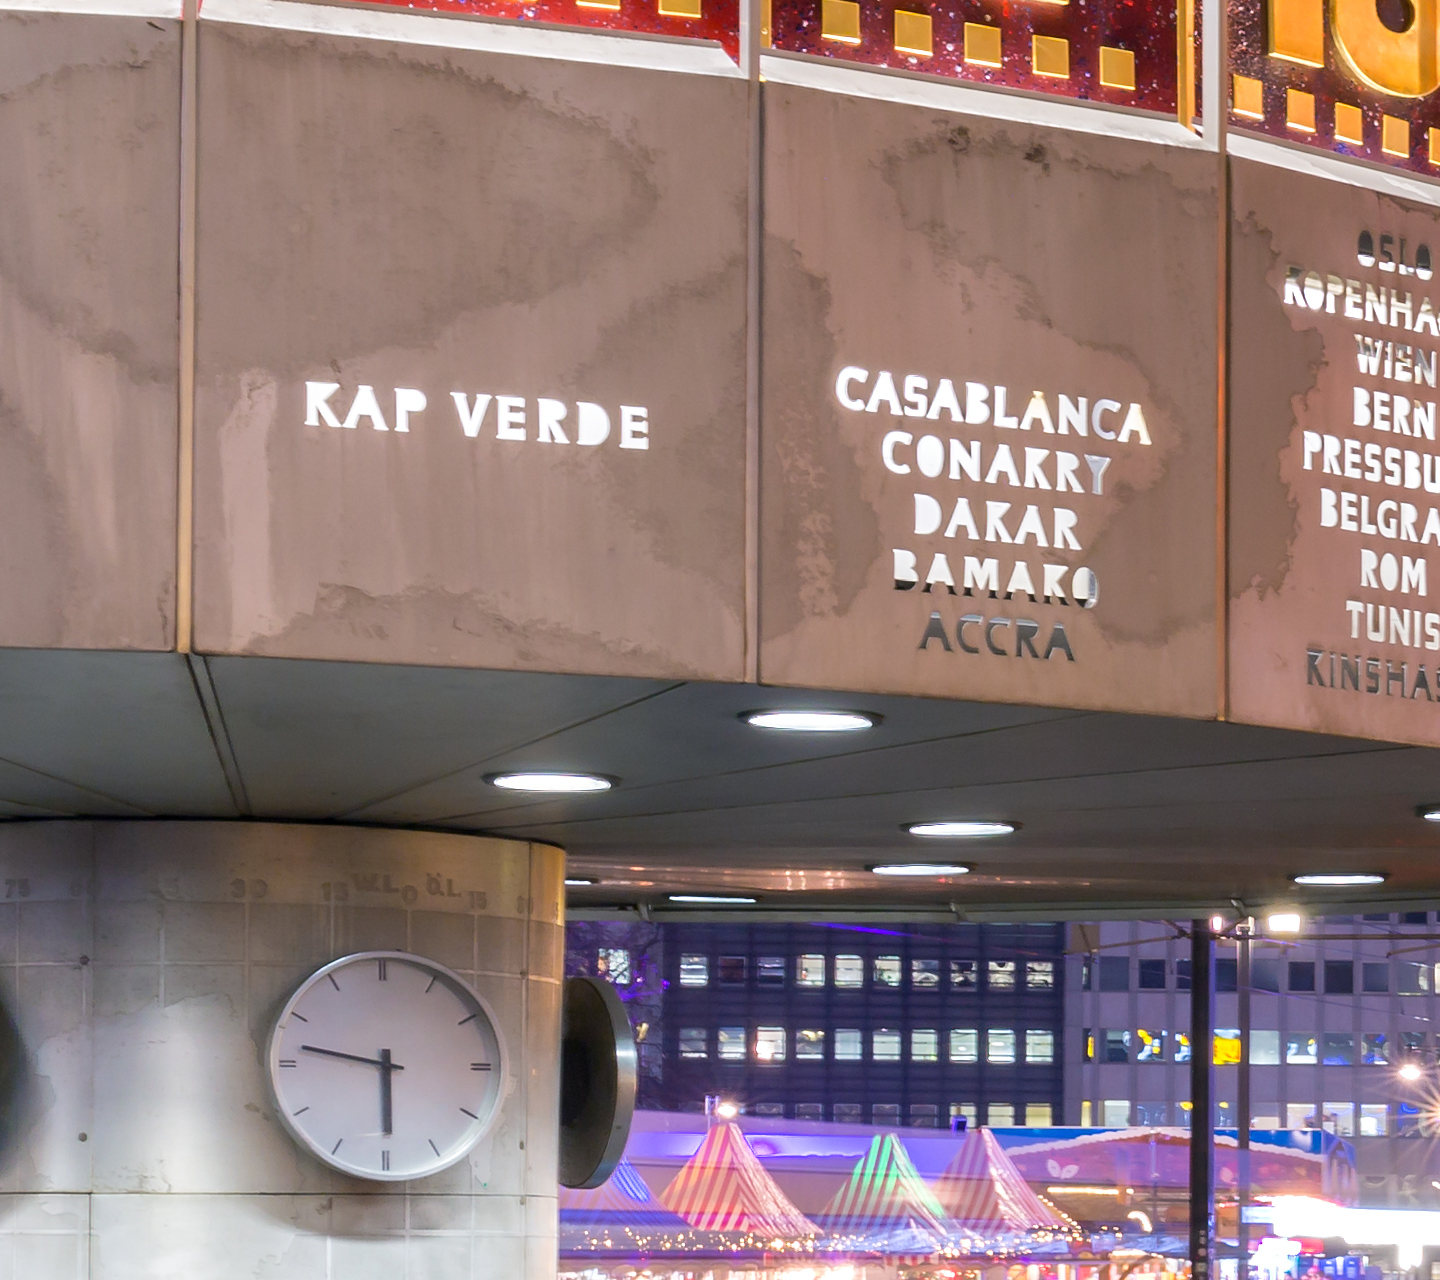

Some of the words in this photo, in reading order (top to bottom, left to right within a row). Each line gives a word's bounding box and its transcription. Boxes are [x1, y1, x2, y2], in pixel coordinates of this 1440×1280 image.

[1356, 229, 1434, 282] OSLO
[1353, 333, 1438, 389] WIEN
[304, 380, 428, 434] KAP
[449, 391, 651, 451] VERDE
[834, 365, 1153, 446] CASABLANCA
[1353, 386, 1438, 442] BERN
[881, 430, 1113, 496] CONAKRY
[912, 493, 1083, 551] DAKAR
[892, 548, 1100, 610] BAMAKO
[1360, 548, 1428, 597] ROM
[917, 611, 1076, 663] ACCRA
